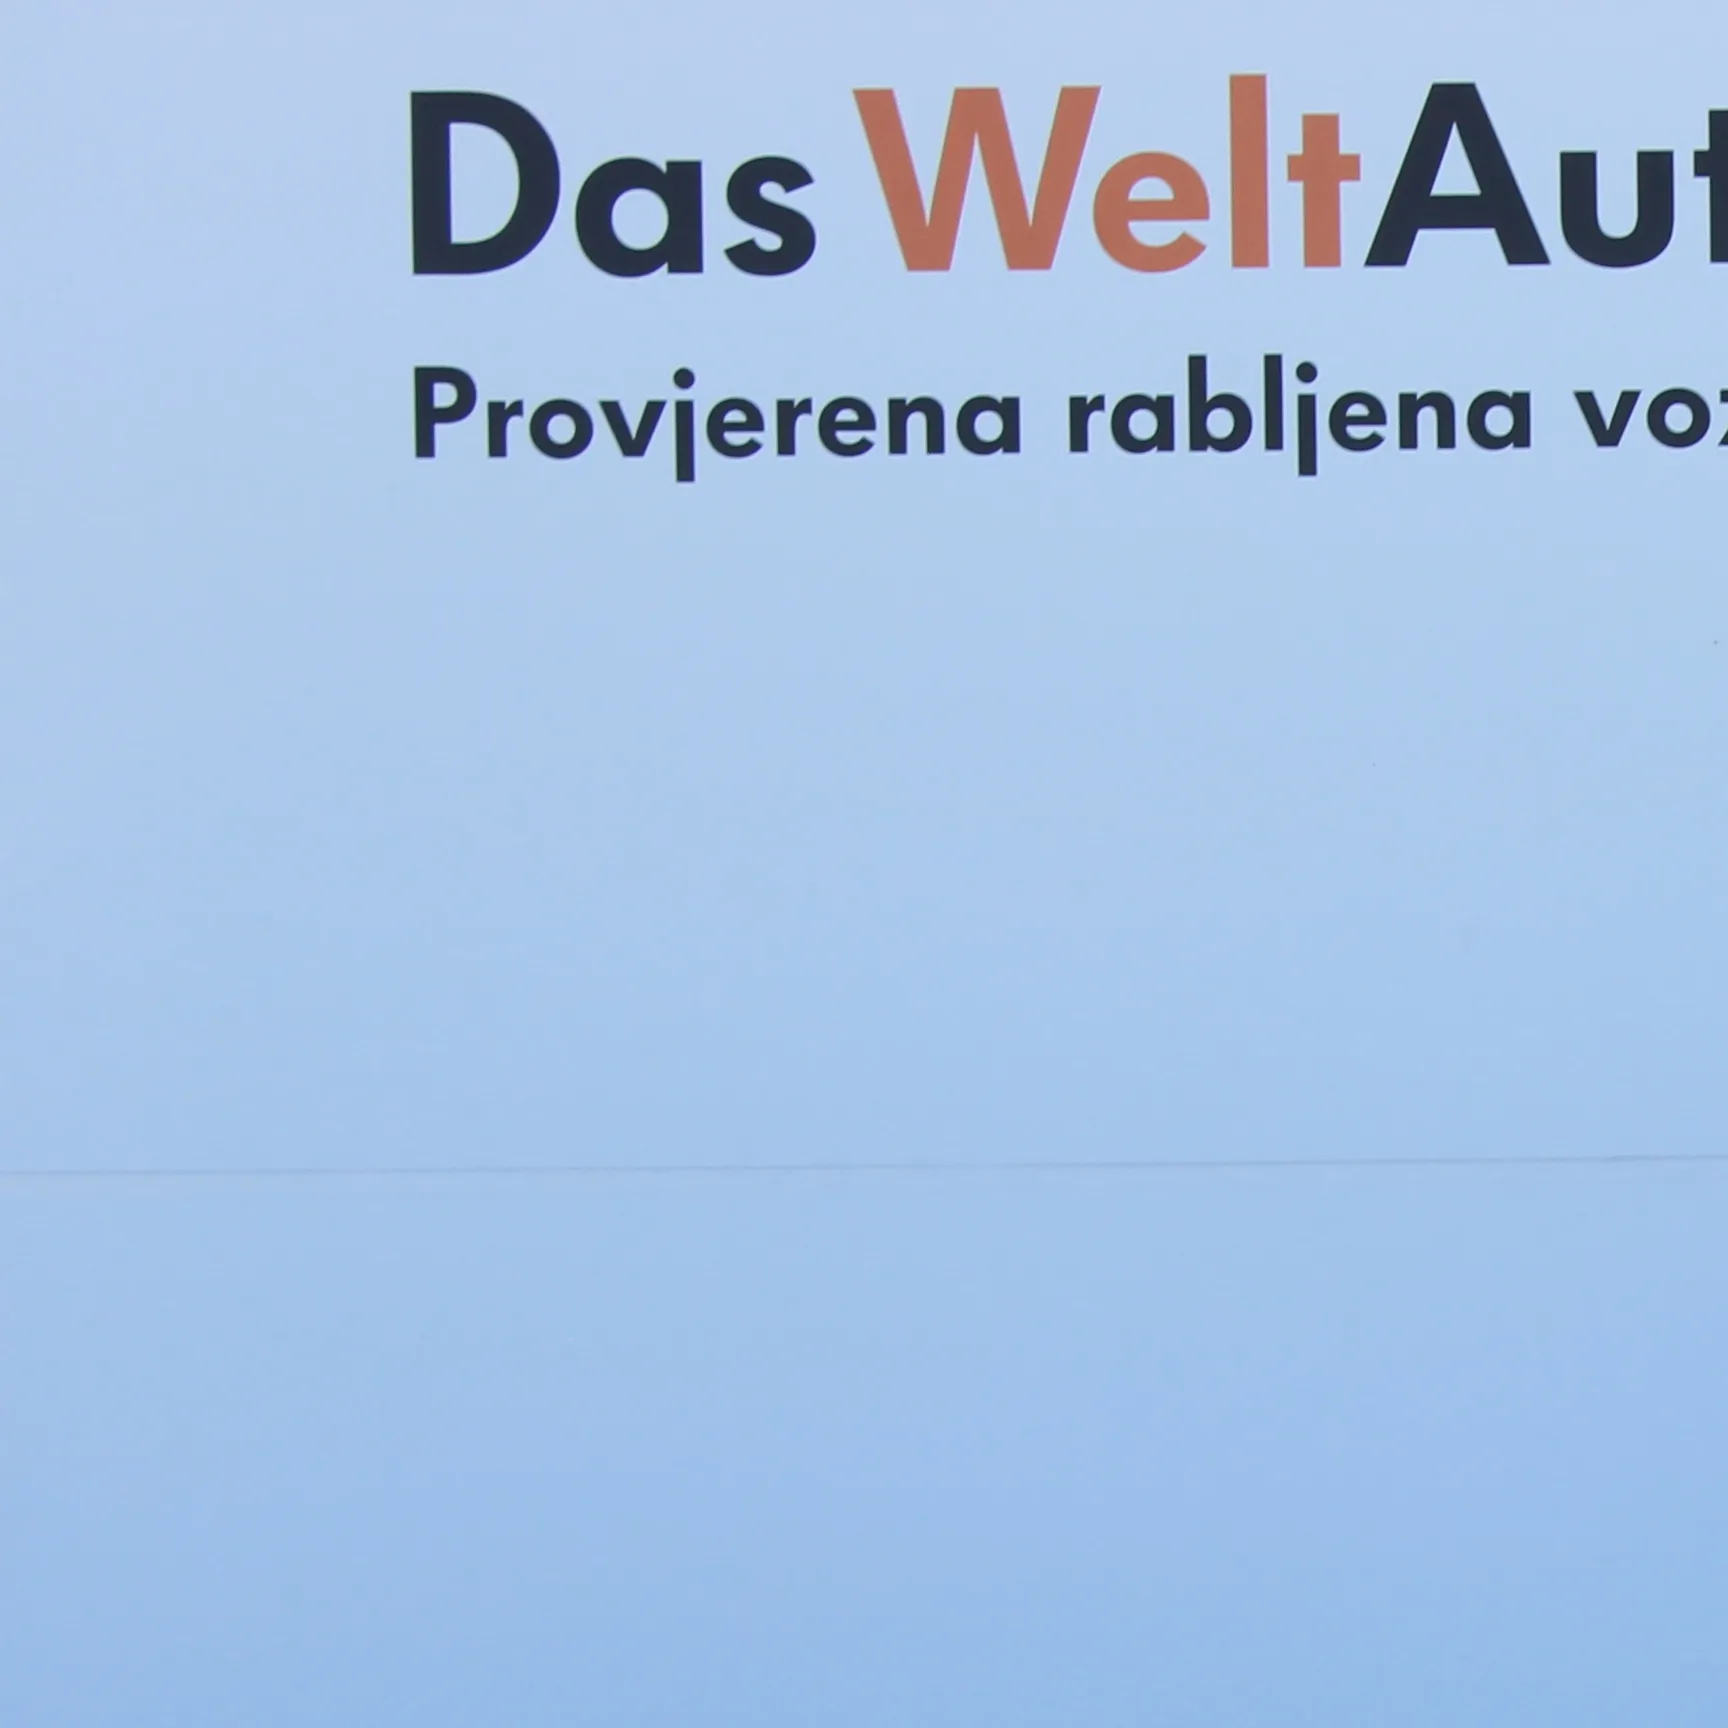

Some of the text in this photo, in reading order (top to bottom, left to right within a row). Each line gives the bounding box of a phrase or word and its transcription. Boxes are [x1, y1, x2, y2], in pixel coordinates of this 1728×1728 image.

[411, 90, 815, 277] Das
[414, 367, 1020, 482] Provjerena
[1069, 354, 1531, 476] rabljena
